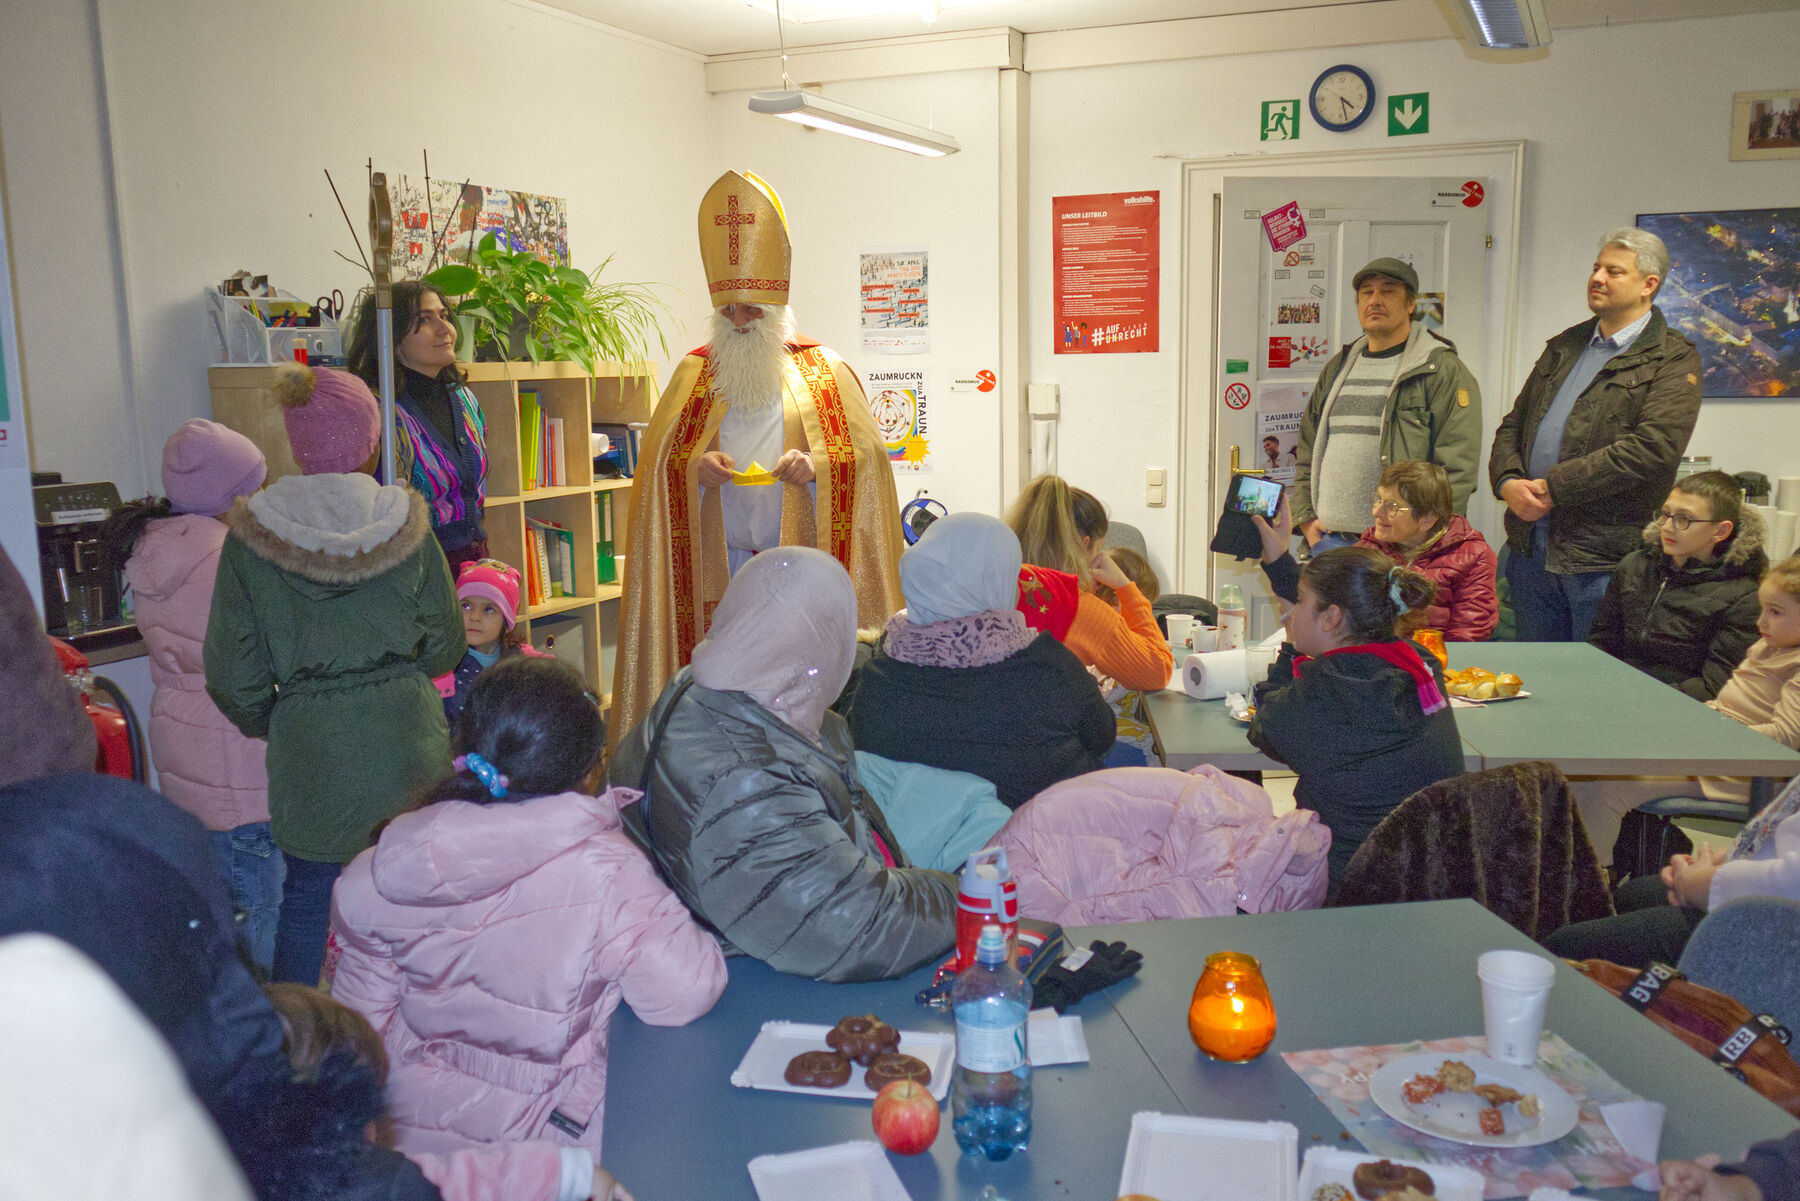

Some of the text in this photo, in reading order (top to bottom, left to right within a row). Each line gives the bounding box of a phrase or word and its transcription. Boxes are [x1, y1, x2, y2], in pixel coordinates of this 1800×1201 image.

[1106, 327, 1147, 344] UNRECHT
[869, 372, 922, 381] ZAUMRUCKN
[1265, 412, 1304, 422] ZAUMRUC
[1630, 966, 1671, 1003] BAG
